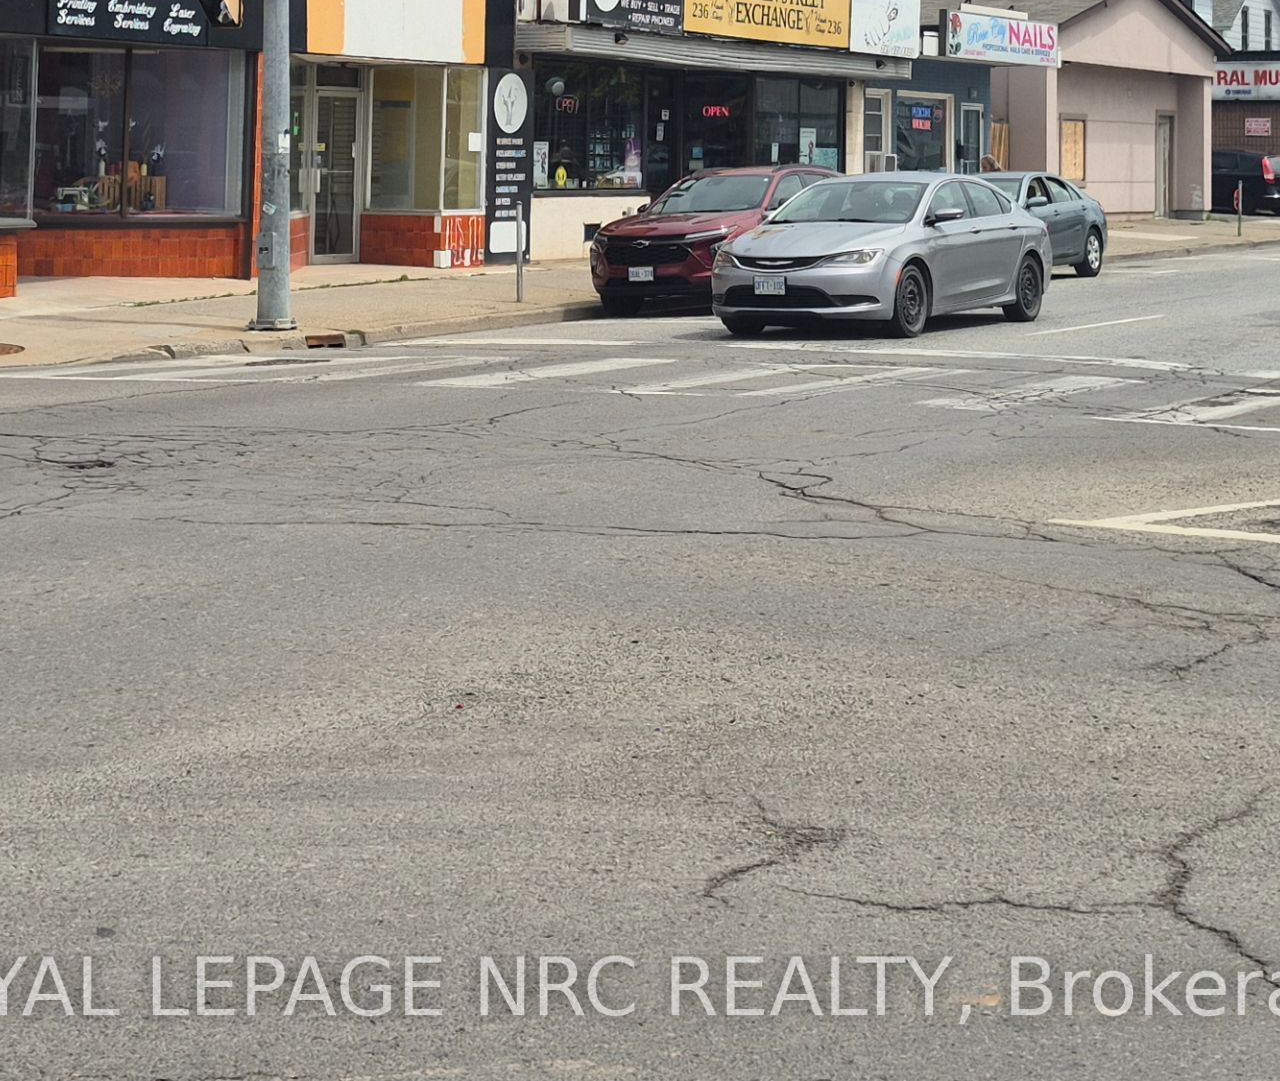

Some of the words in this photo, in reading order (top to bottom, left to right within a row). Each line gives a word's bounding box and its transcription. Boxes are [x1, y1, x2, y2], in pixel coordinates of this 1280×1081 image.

[169, 3, 195, 18] Laser
[631, 0, 642, 9] BUY
[647, 1, 659, 12] SELL
[664, 3, 680, 15] TRADE
[692, 2, 709, 19] 236
[57, 10, 95, 26] Services
[114, 14, 150, 30] Services
[632, 13, 651, 24] REPAIR
[736, 1, 804, 30] EXCHANGE
[827, 20, 842, 35] 236
[1008, 21, 1055, 51] NAILS
[1217, 70, 1250, 85] RAL
[702, 105, 729, 117] OPEN
